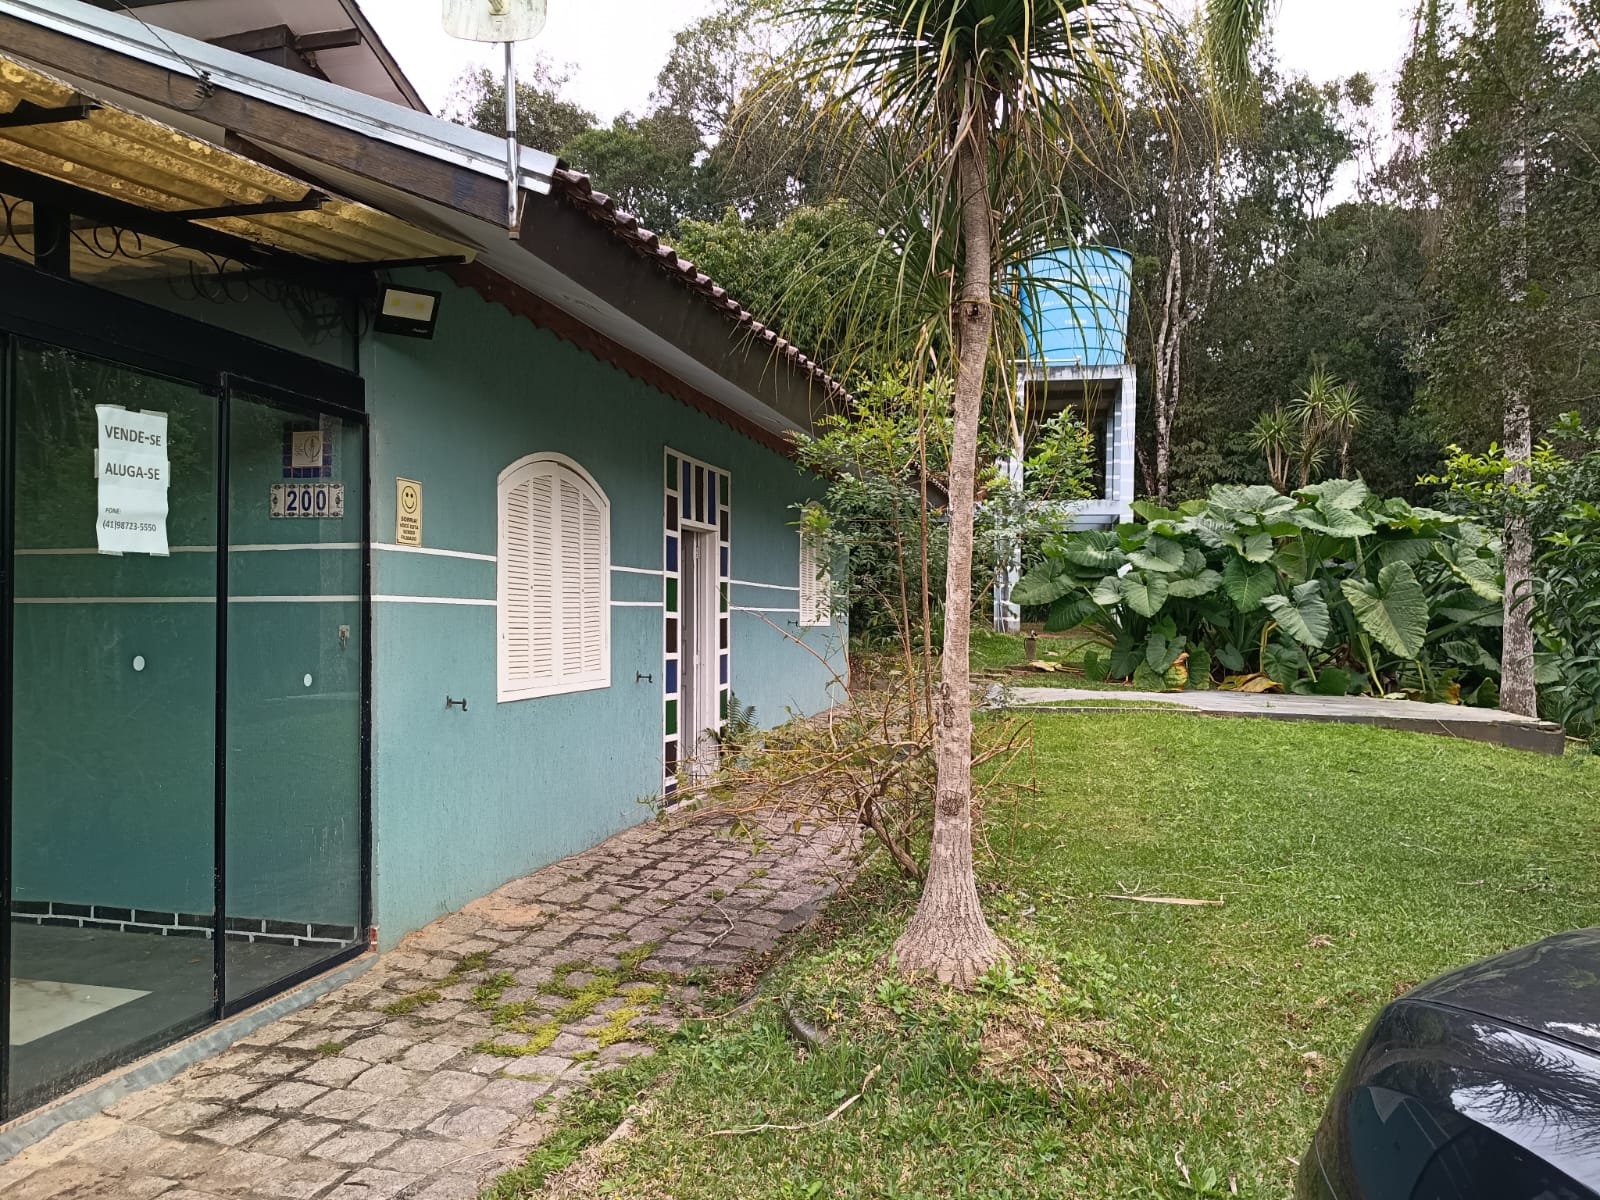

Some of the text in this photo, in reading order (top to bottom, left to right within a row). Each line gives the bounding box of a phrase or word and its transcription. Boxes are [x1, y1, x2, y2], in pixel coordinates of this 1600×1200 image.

[105, 425, 161, 446] VENDE-SE
[105, 462, 160, 480] ALUGA-SE
[287, 490, 327, 511] 200
